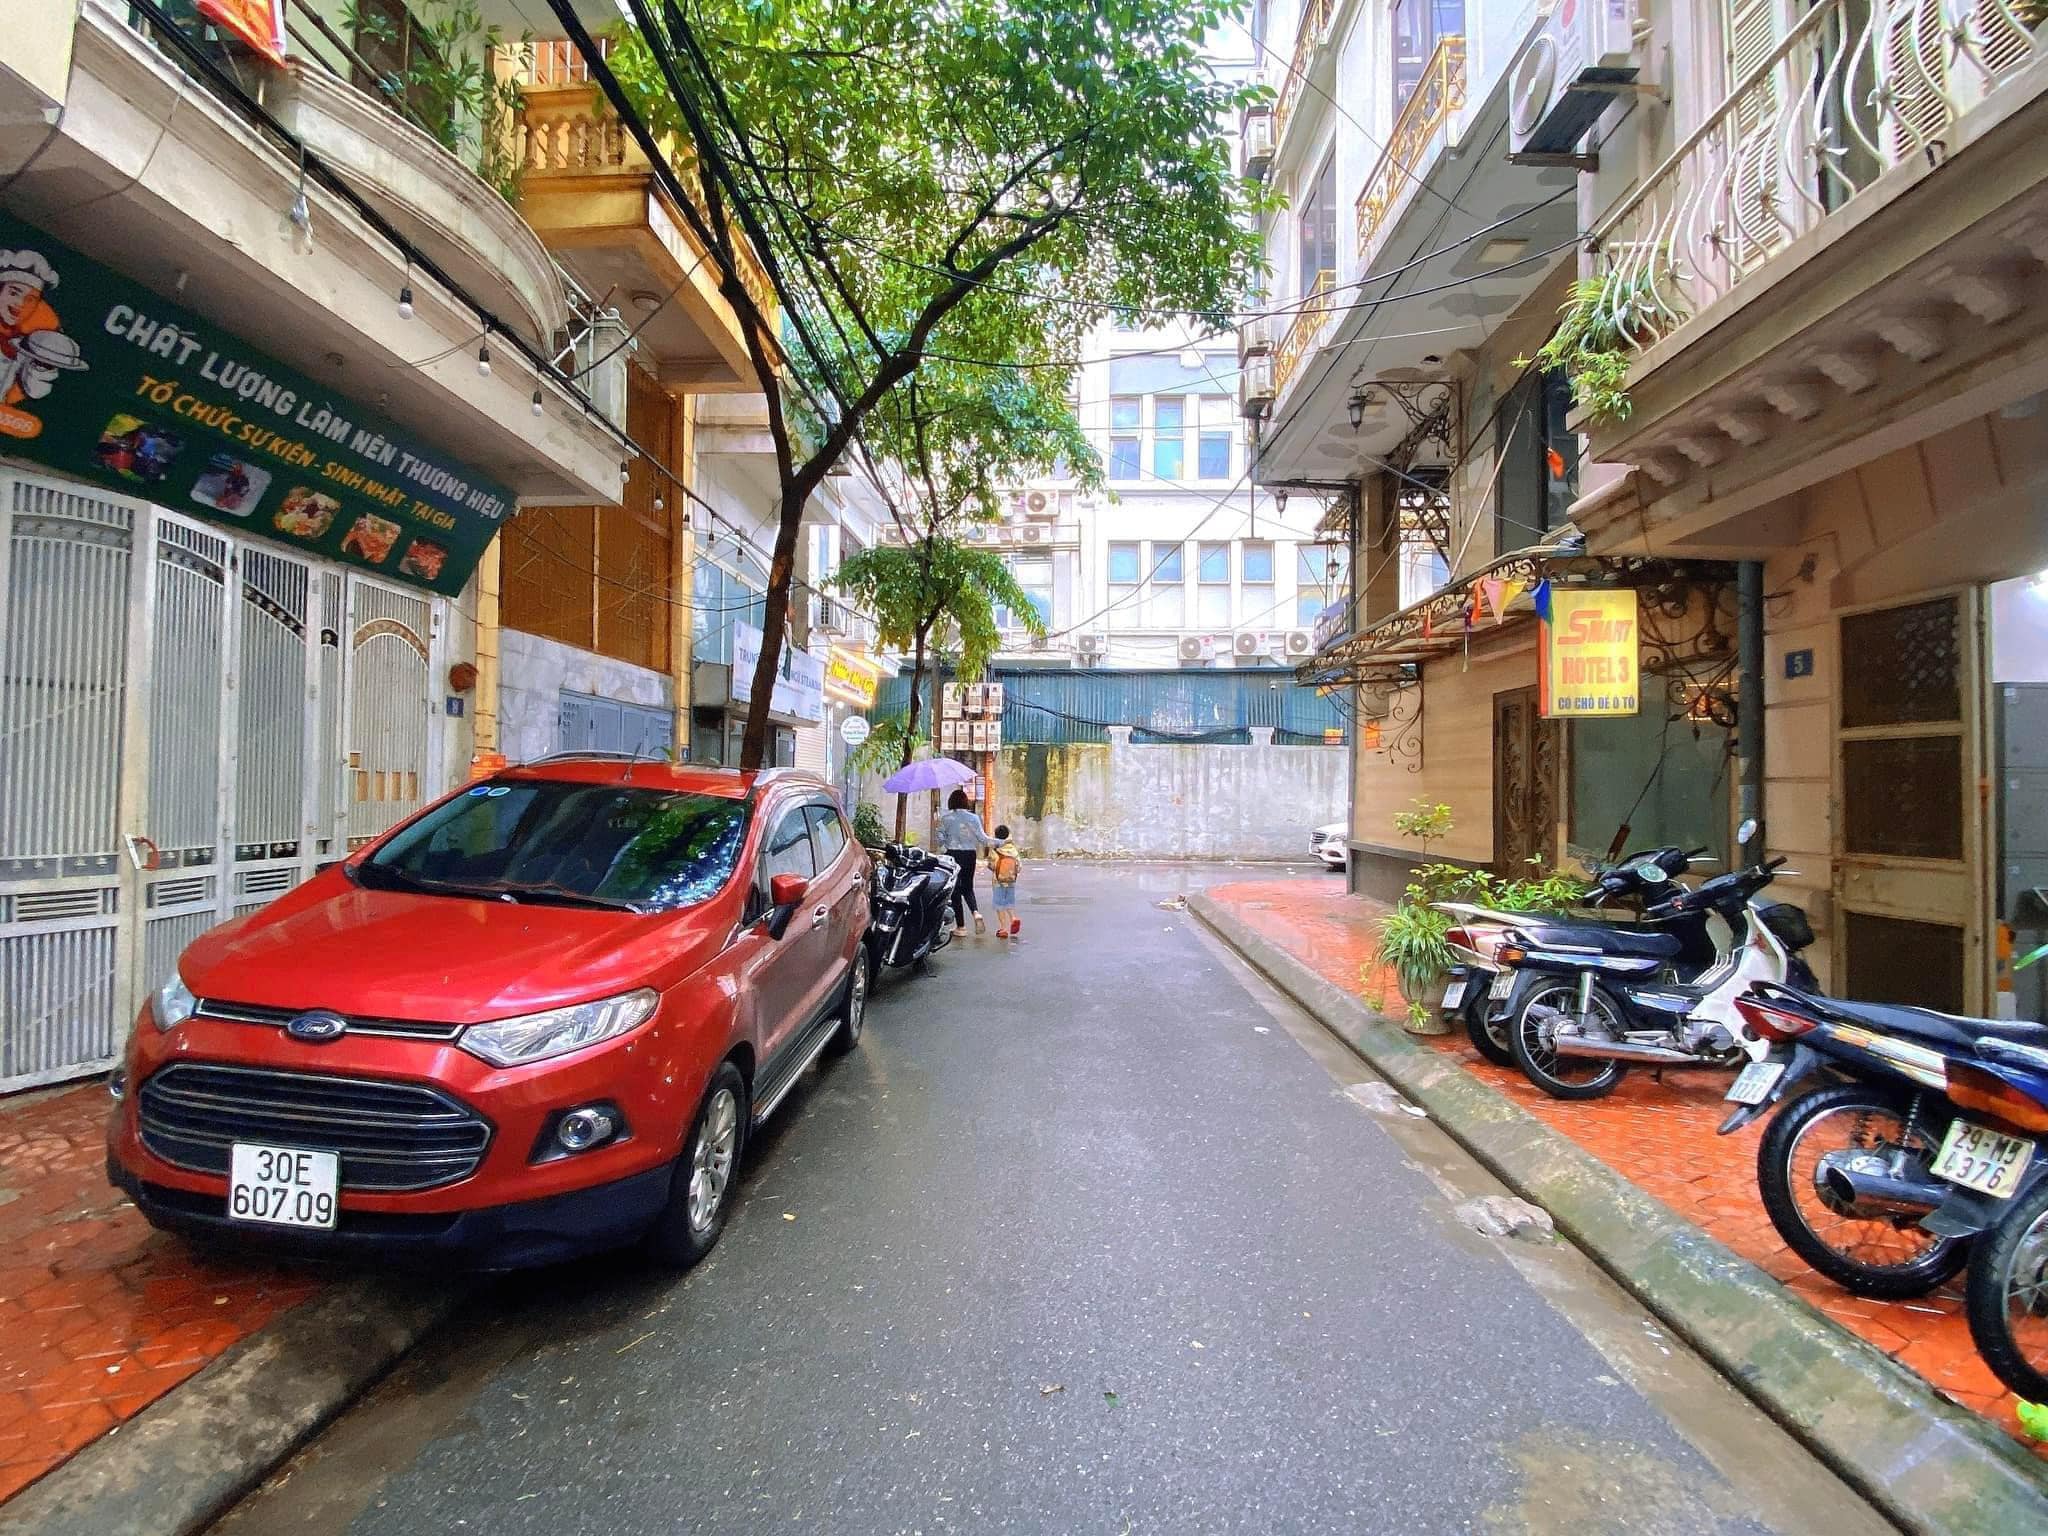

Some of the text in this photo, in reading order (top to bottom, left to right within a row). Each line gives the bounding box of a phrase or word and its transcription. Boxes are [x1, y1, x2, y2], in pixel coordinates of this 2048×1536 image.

[104, 304, 505, 520] CHẤT LƯỢNG LÀM NÊN THƯƠNG HIỆU
[173, 395, 242, 434] CHỨC
[238, 423, 274, 450] SỰ
[320, 461, 367, 491] SINH
[432, 511, 456, 530] GIA
[1794, 655, 1804, 674] 5
[296, 1017, 330, 1034] Ford
[256, 1149, 313, 1186] 30E
[1942, 1151, 2006, 1189] 4376
[232, 1183, 334, 1224] 607.09
